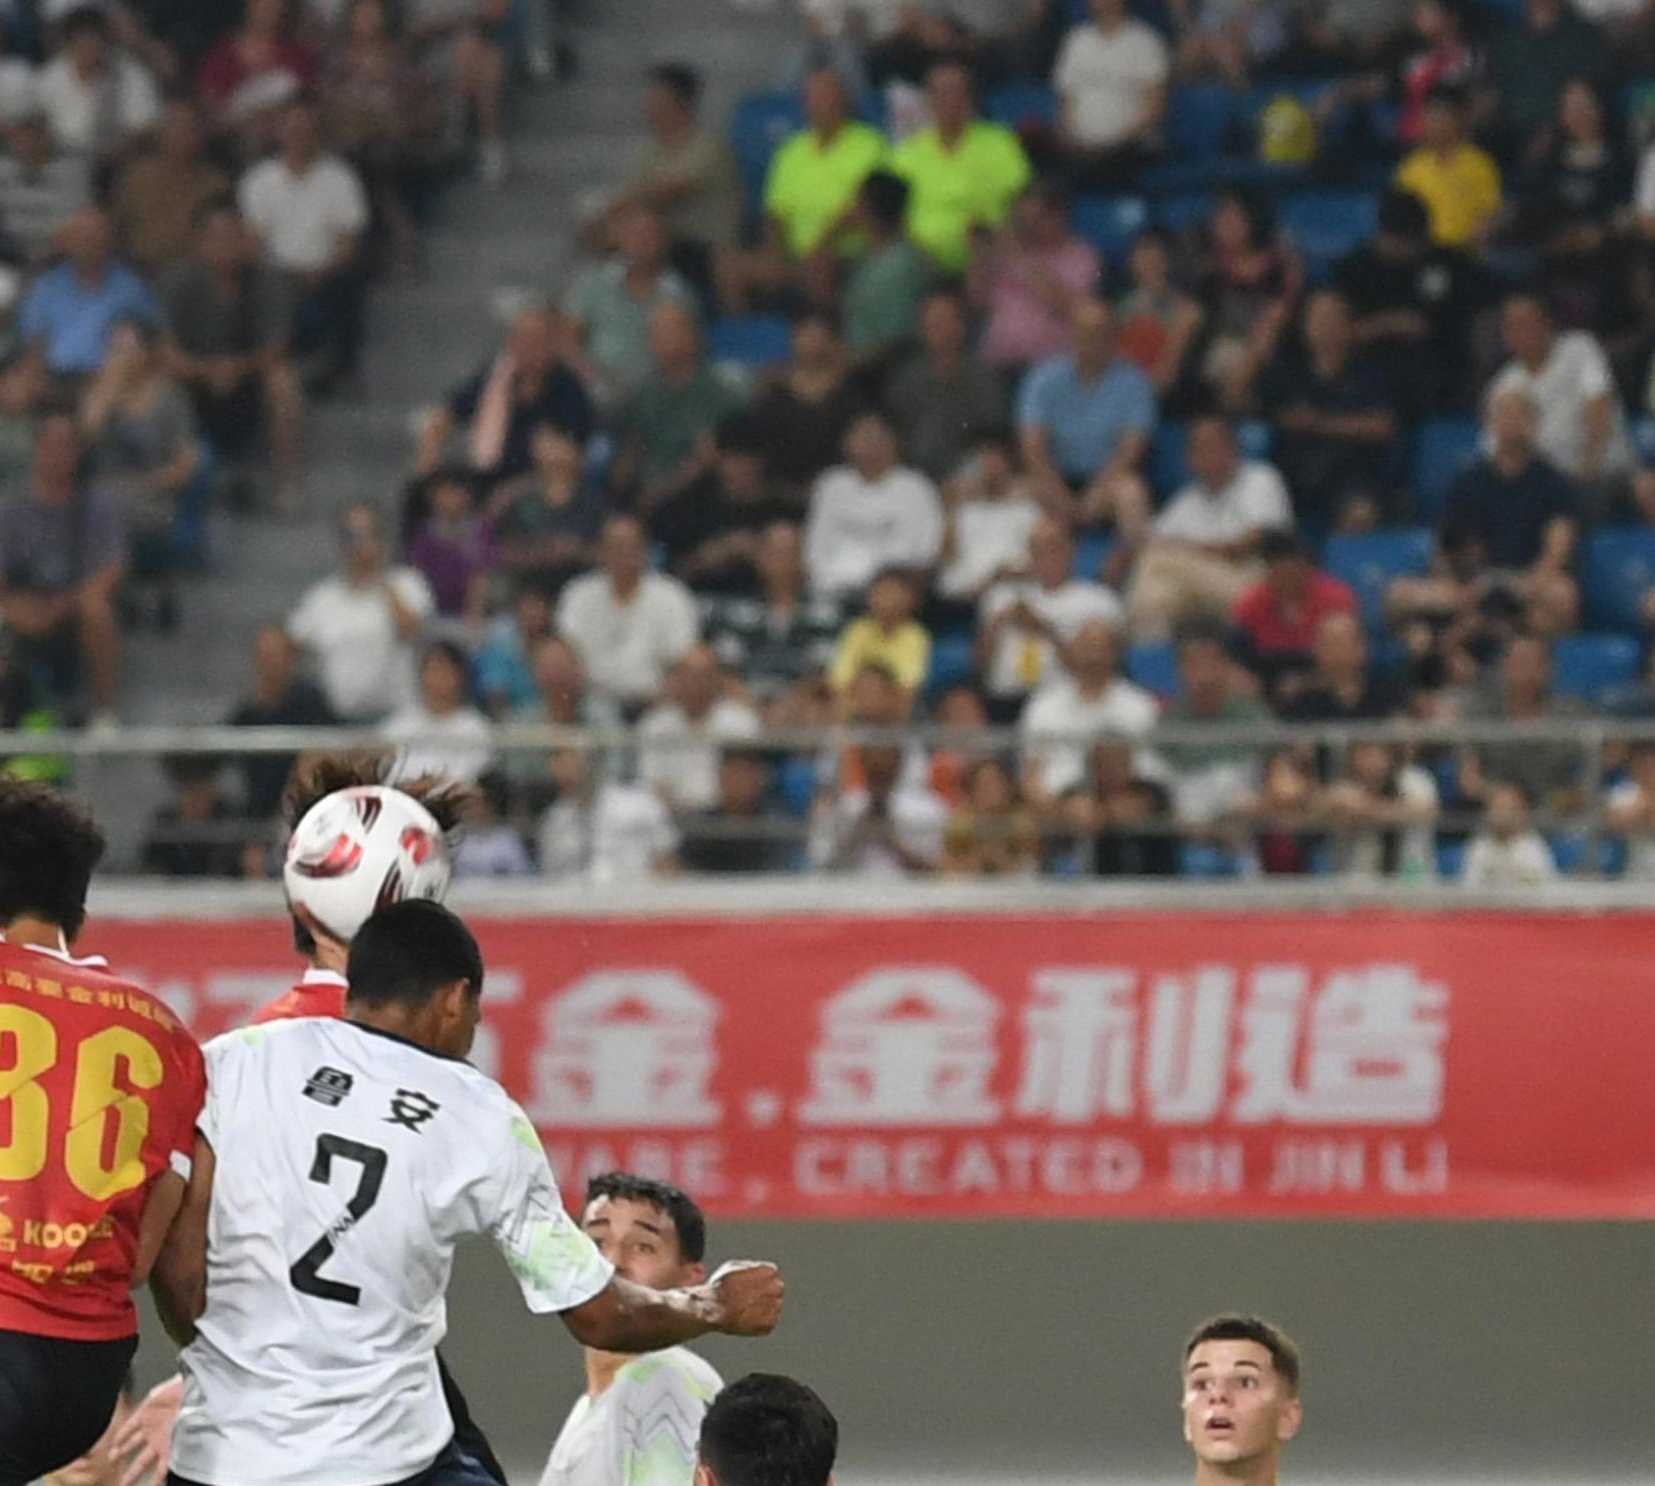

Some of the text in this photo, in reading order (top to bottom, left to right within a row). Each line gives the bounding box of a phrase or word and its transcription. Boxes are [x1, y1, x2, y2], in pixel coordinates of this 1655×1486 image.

[302, 1065, 441, 1136] 鲁安
[793, 1137, 1142, 1197] CREATED
[289, 1132, 388, 1307] 2
